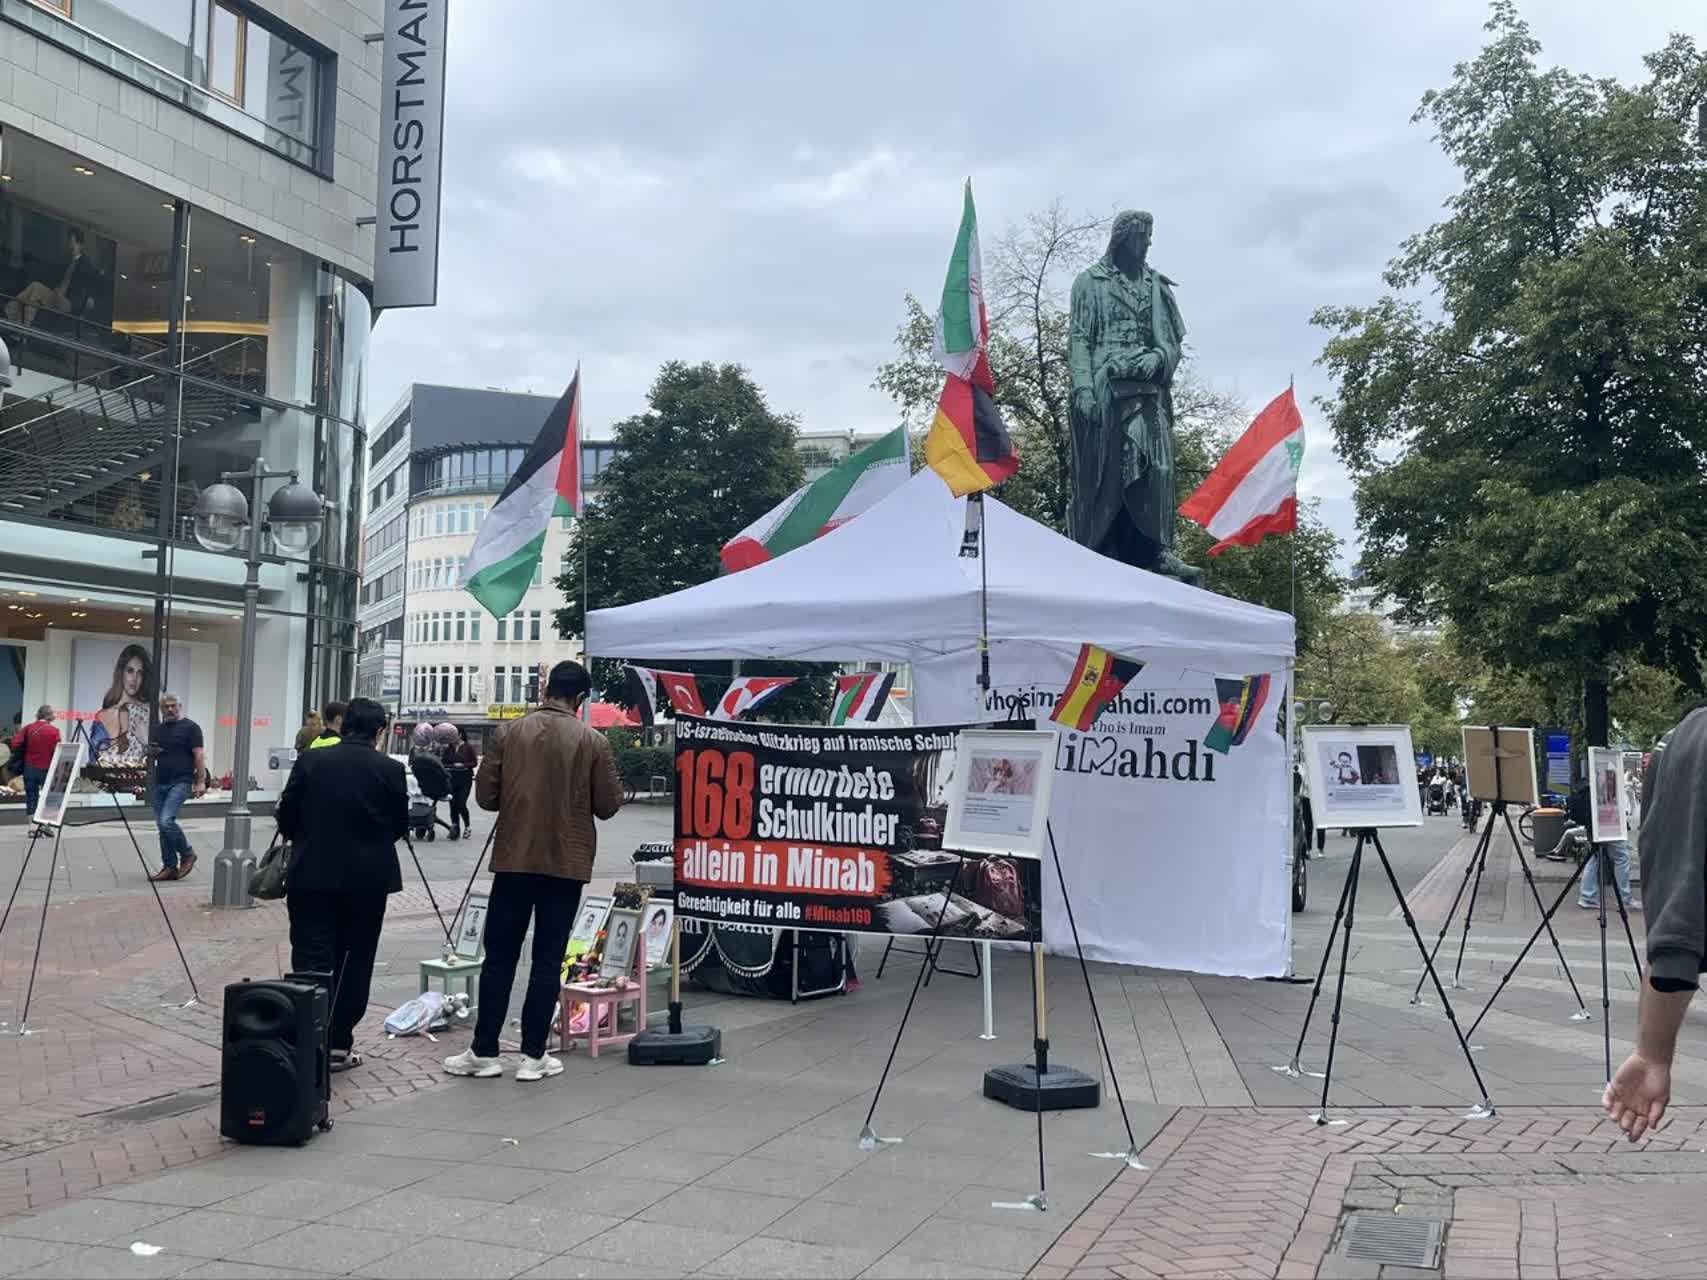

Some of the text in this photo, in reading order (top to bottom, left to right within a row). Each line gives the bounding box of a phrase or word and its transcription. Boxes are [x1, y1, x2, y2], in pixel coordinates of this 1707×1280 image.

[760, 731, 820, 754] Blitzkrieg
[823, 734, 845, 751] auf
[847, 735, 913, 751] iranische
[1117, 721, 1127, 734] is
[1129, 722, 1167, 736] Imam
[676, 750, 755, 838] 168
[760, 764, 895, 800] ermordete
[757, 798, 899, 845] Schulkinder
[683, 842, 875, 892] allein in Minab
[678, 891, 750, 916] Gerechtigkeit
[753, 900, 774, 918] für
[776, 902, 800, 919] alle
